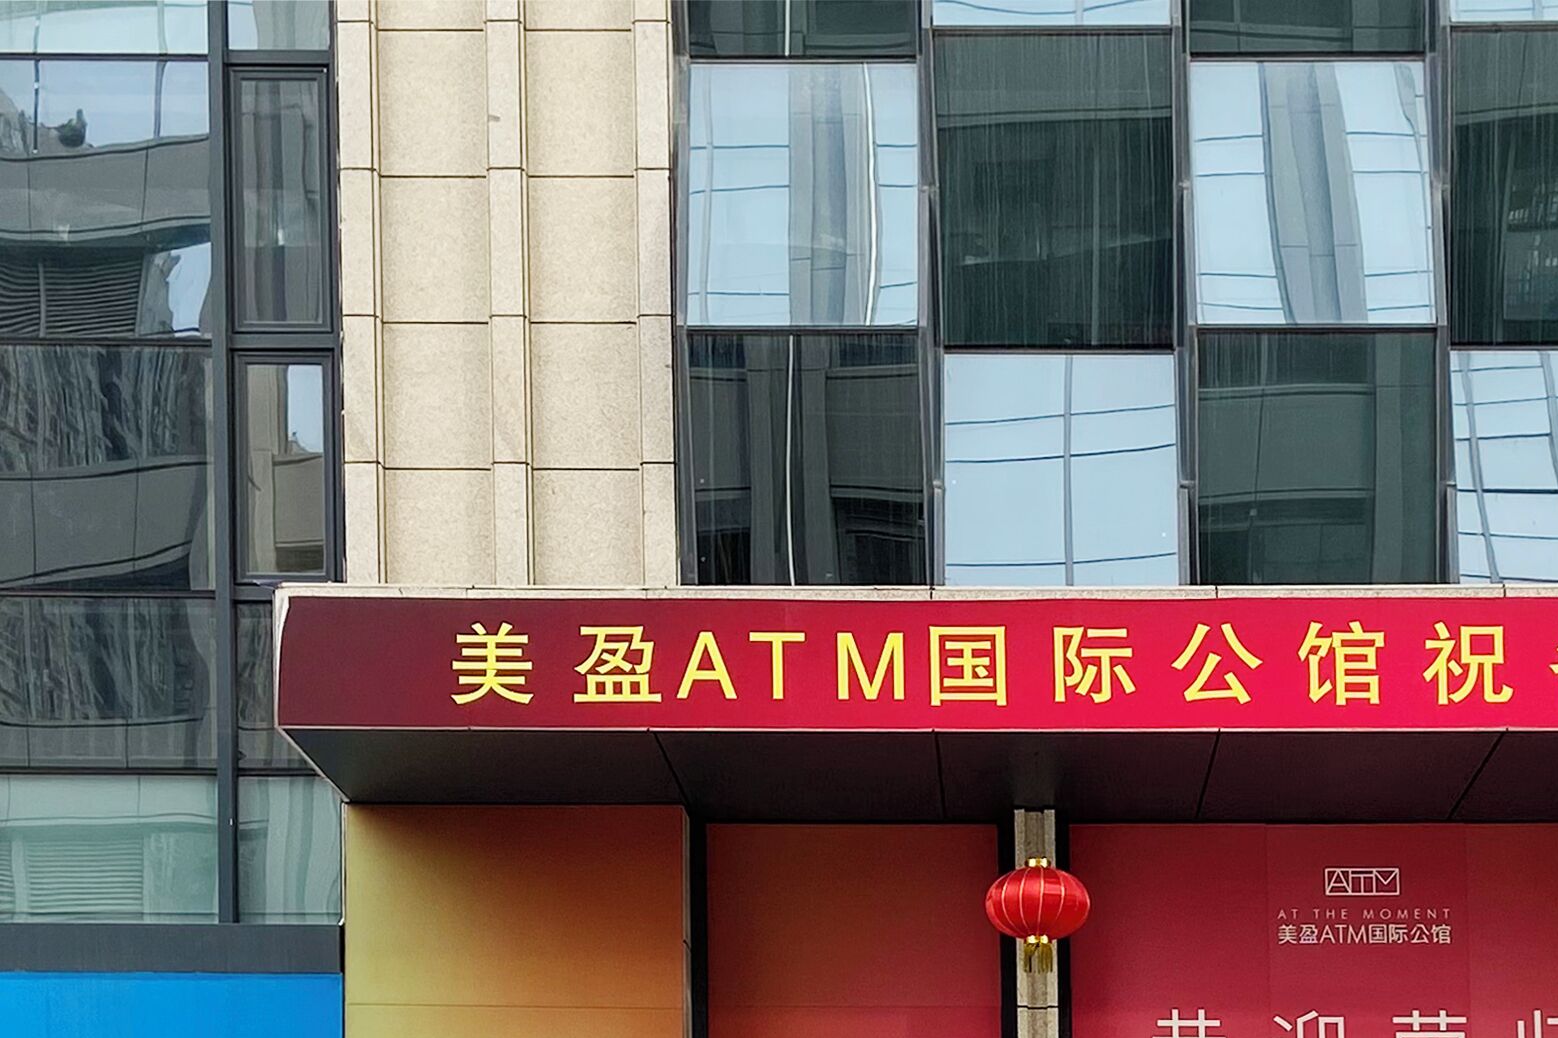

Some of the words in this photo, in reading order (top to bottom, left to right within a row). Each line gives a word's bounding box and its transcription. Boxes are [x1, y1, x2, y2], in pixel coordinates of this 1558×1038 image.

[1325, 867, 1400, 896] ATM
[1277, 908, 1299, 920] AT
[1313, 908, 1349, 920] THE
[1362, 908, 1451, 920] MOMENT
[1278, 923, 1451, 945] 美盈ATM国际公馆
